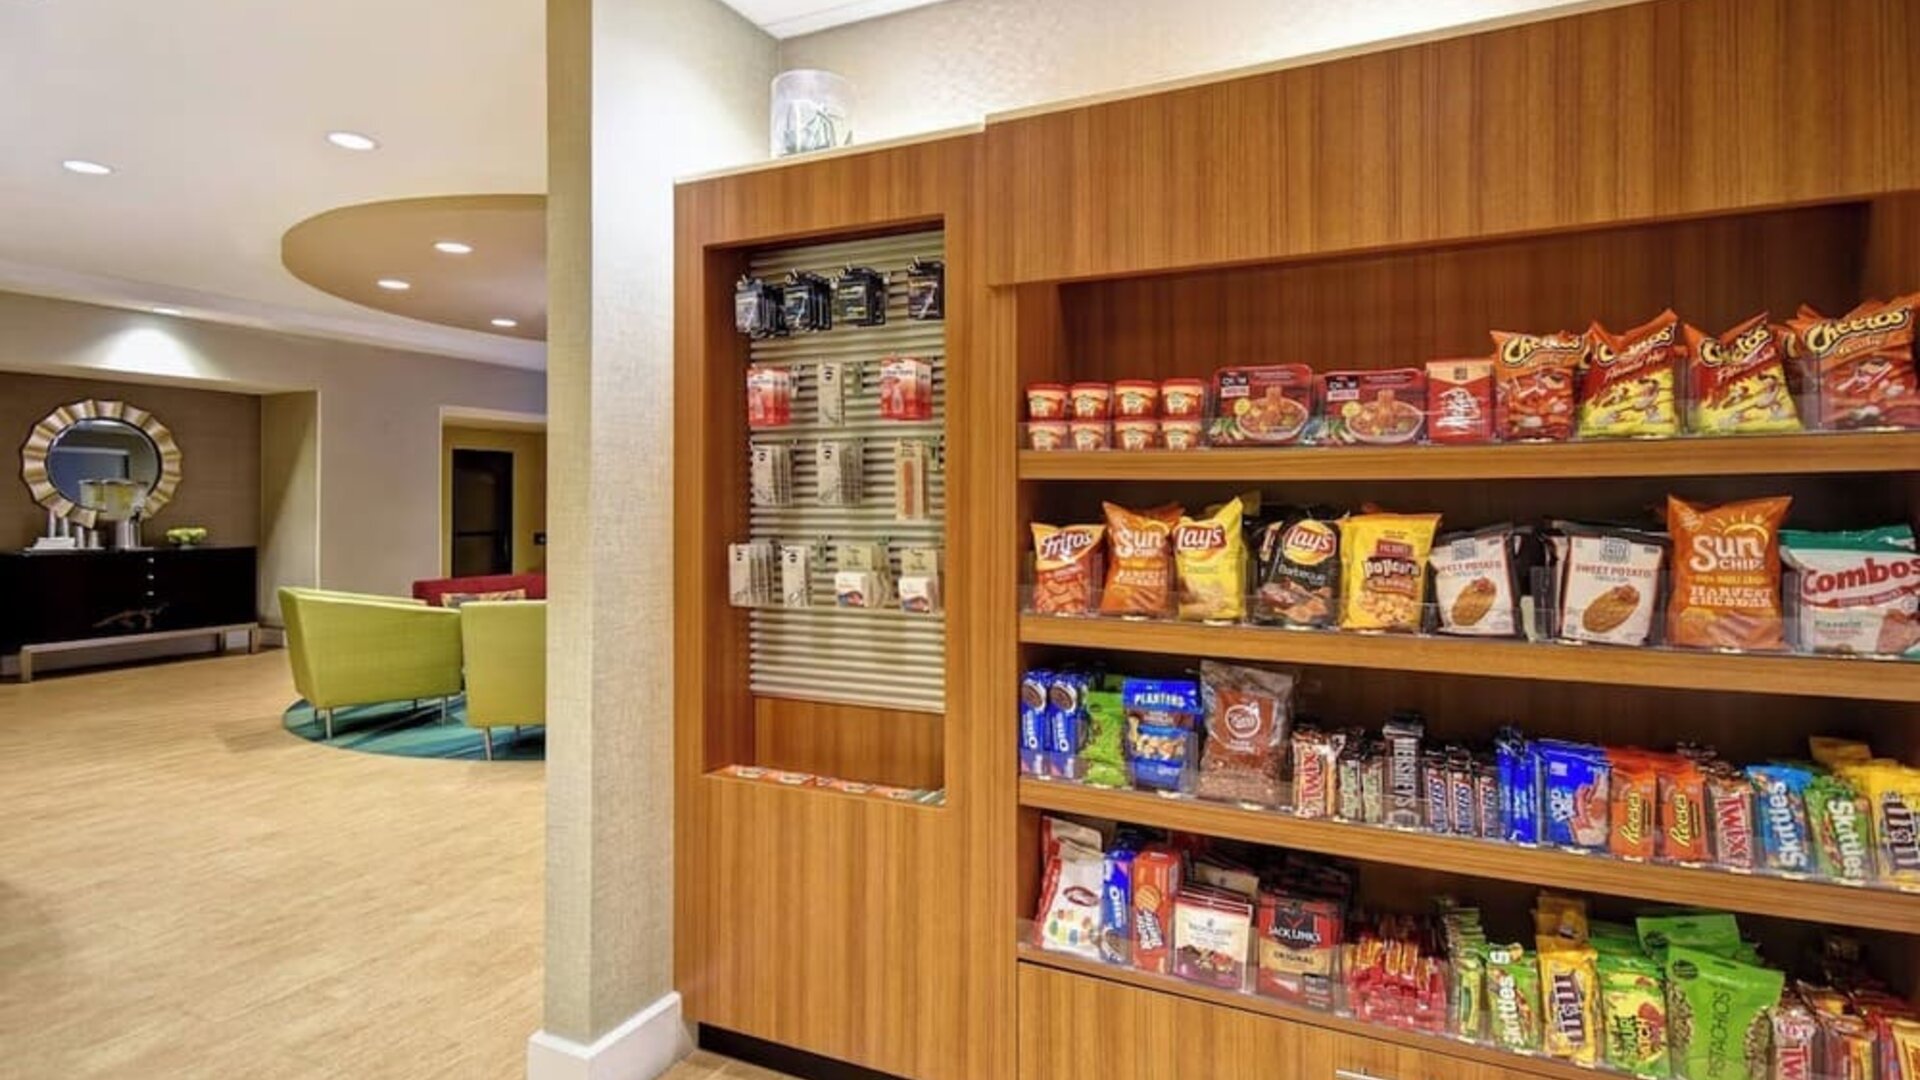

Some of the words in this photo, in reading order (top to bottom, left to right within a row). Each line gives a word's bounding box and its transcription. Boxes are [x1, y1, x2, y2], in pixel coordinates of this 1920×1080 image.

[1502, 336, 1582, 364] Ches
[1596, 323, 1674, 364] Cetos
[1806, 307, 1908, 353] Cheetos
[1040, 530, 1093, 557] Fritos
[1116, 527, 1163, 557] Sun
[1689, 535, 1765, 572] Sun
[1689, 585, 1773, 599] HARVEST
[1803, 557, 1920, 596] Combos
[1134, 692, 1186, 709] PLANTERS
[1395, 738, 1418, 807] HERSHEY'S
[1768, 780, 1805, 868] Skittles
[1827, 798, 1864, 878] Skittles
[1497, 975, 1523, 1045] Skittles
[1708, 991, 1731, 1078] PISTACHIOS
